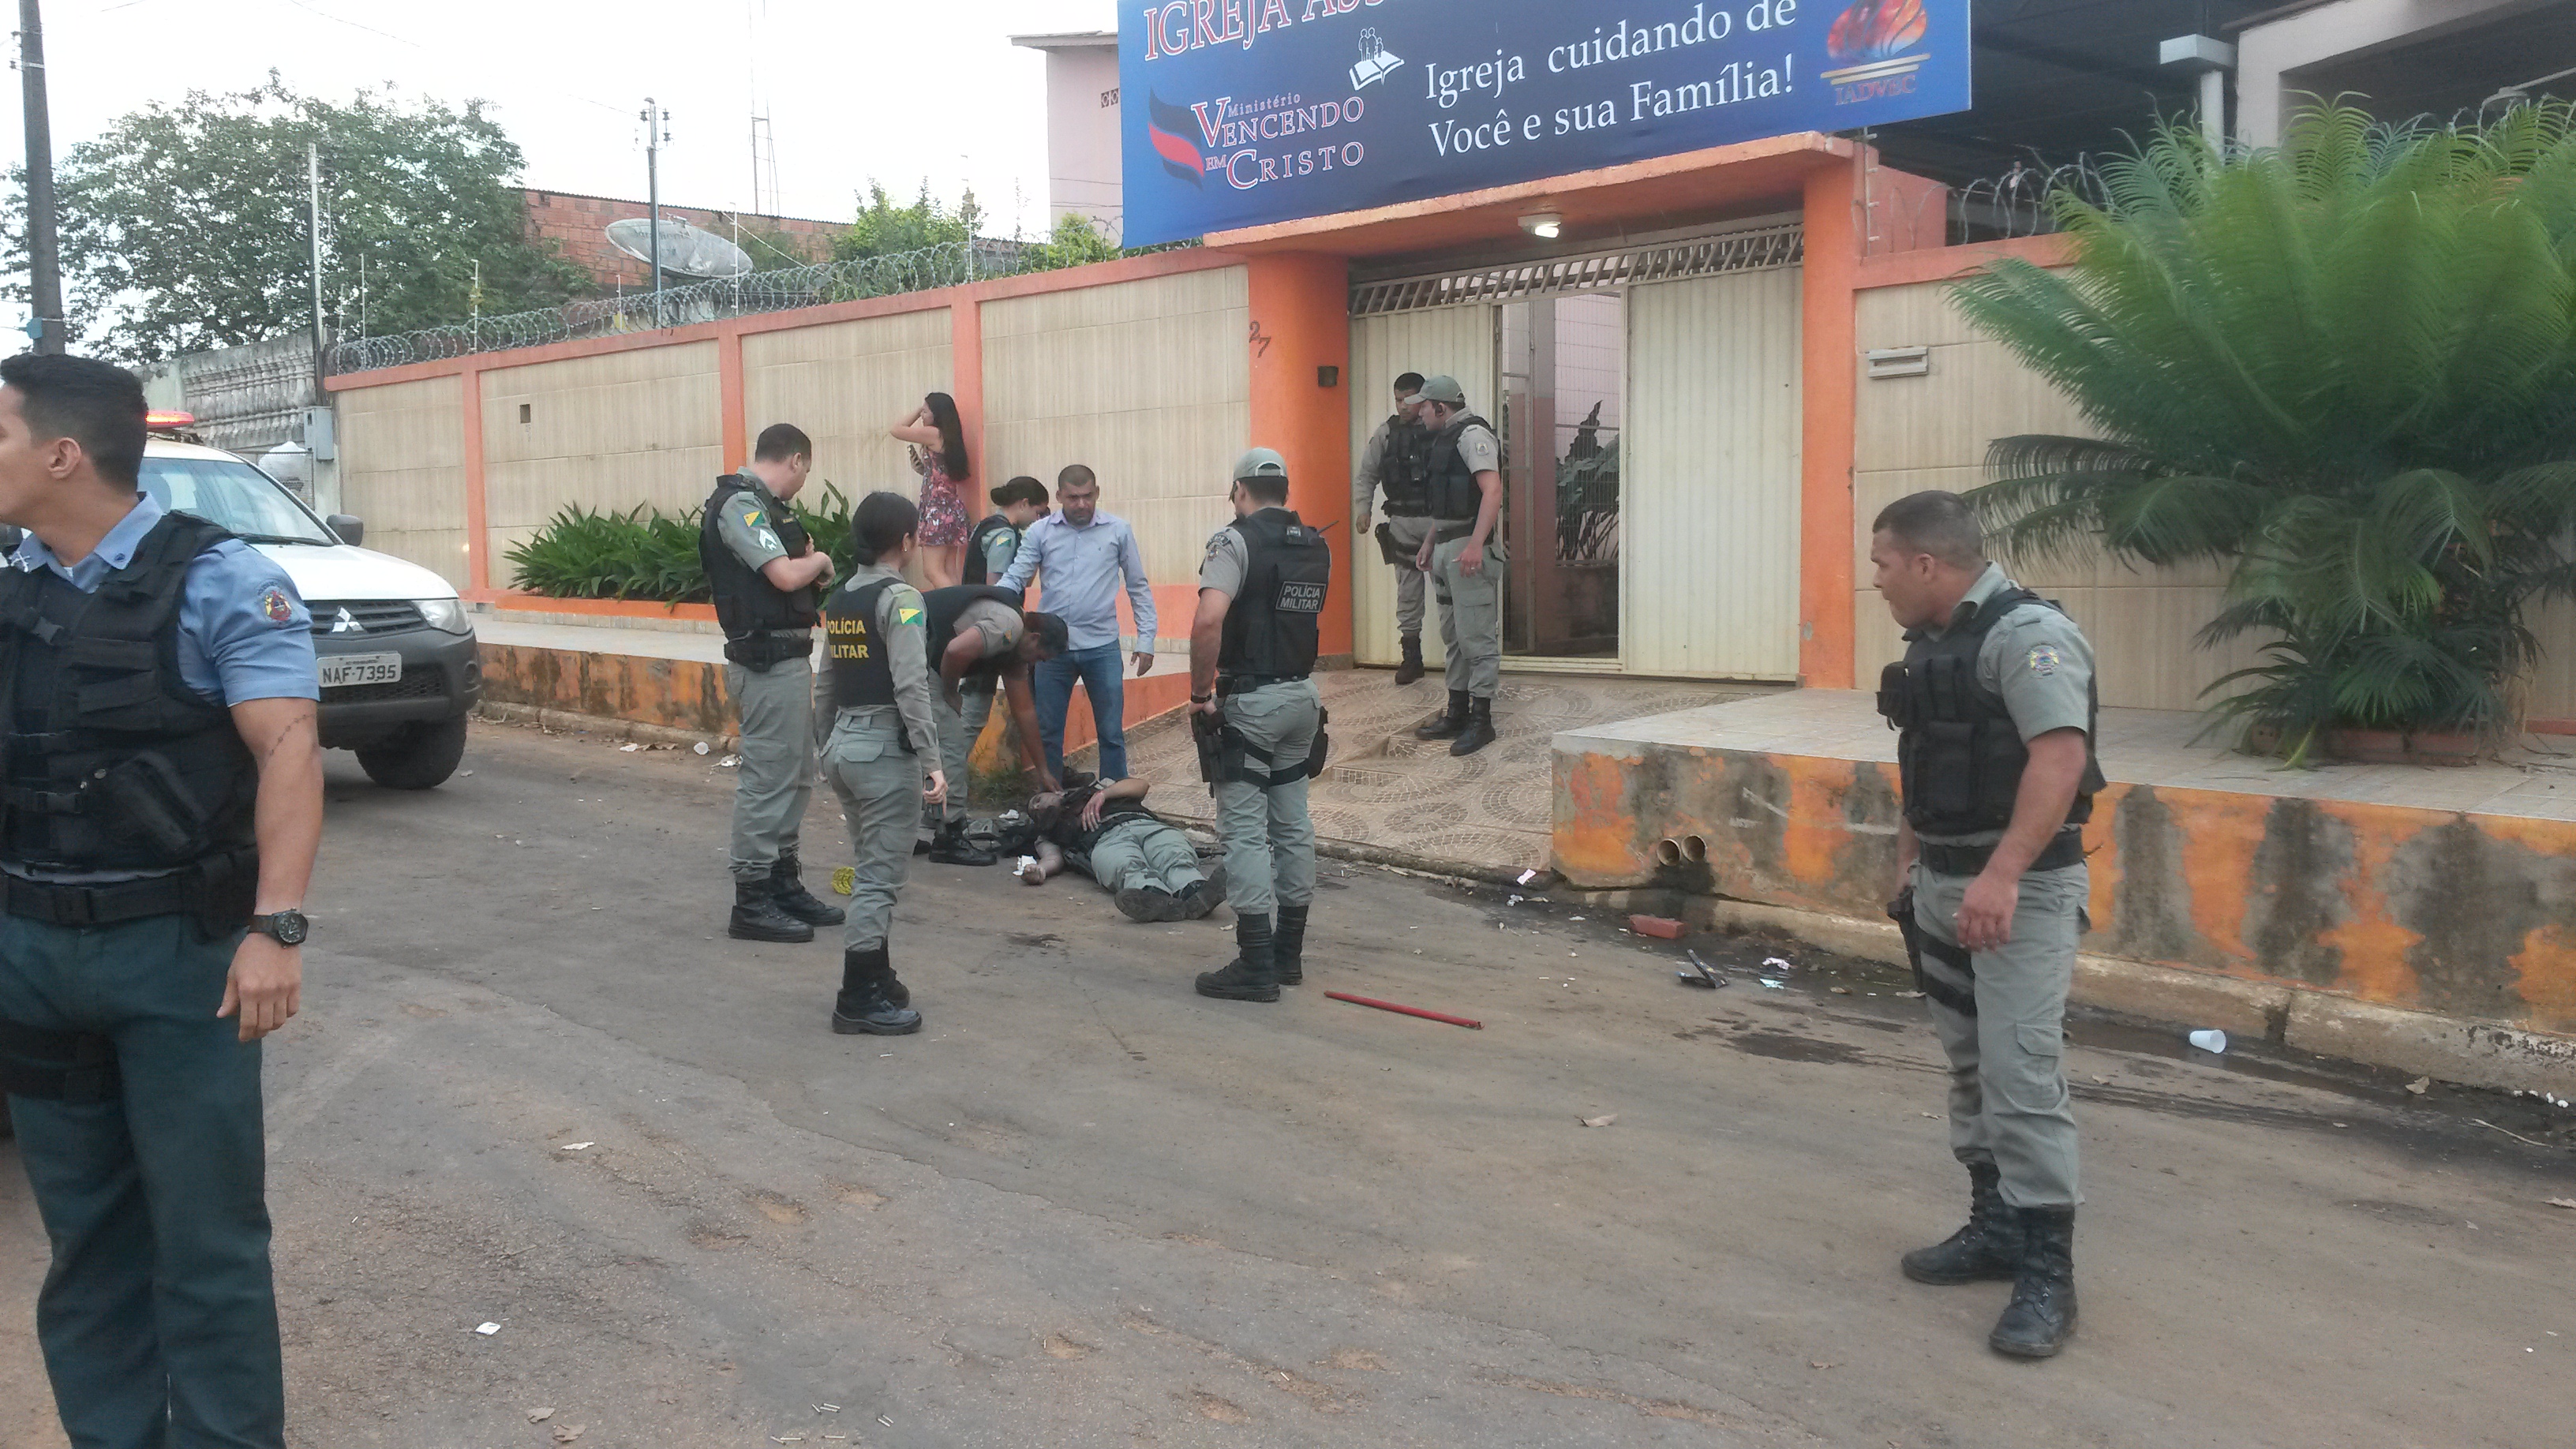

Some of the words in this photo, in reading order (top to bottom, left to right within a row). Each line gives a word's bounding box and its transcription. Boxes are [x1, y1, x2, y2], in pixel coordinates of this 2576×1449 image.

[1144, 0, 1291, 61] IGREJA
[1425, 49, 1526, 108] Igreja
[1548, 2, 1732, 73] cuidando
[1746, 0, 1796, 32] de
[1191, 95, 1365, 148] VENCENDO
[1227, 92, 1301, 118] Ministério
[1428, 108, 1511, 157] Você
[1522, 114, 1541, 140] e
[1555, 100, 1617, 135] sua
[1629, 53, 1793, 122] Família!
[1205, 154, 1227, 171] EM
[1226, 141, 1365, 190] CRISTO
[1249, 320, 1271, 358] 27
[1279, 597, 1319, 610] MILITAR
[1284, 585, 1320, 598] POLÍCIA
